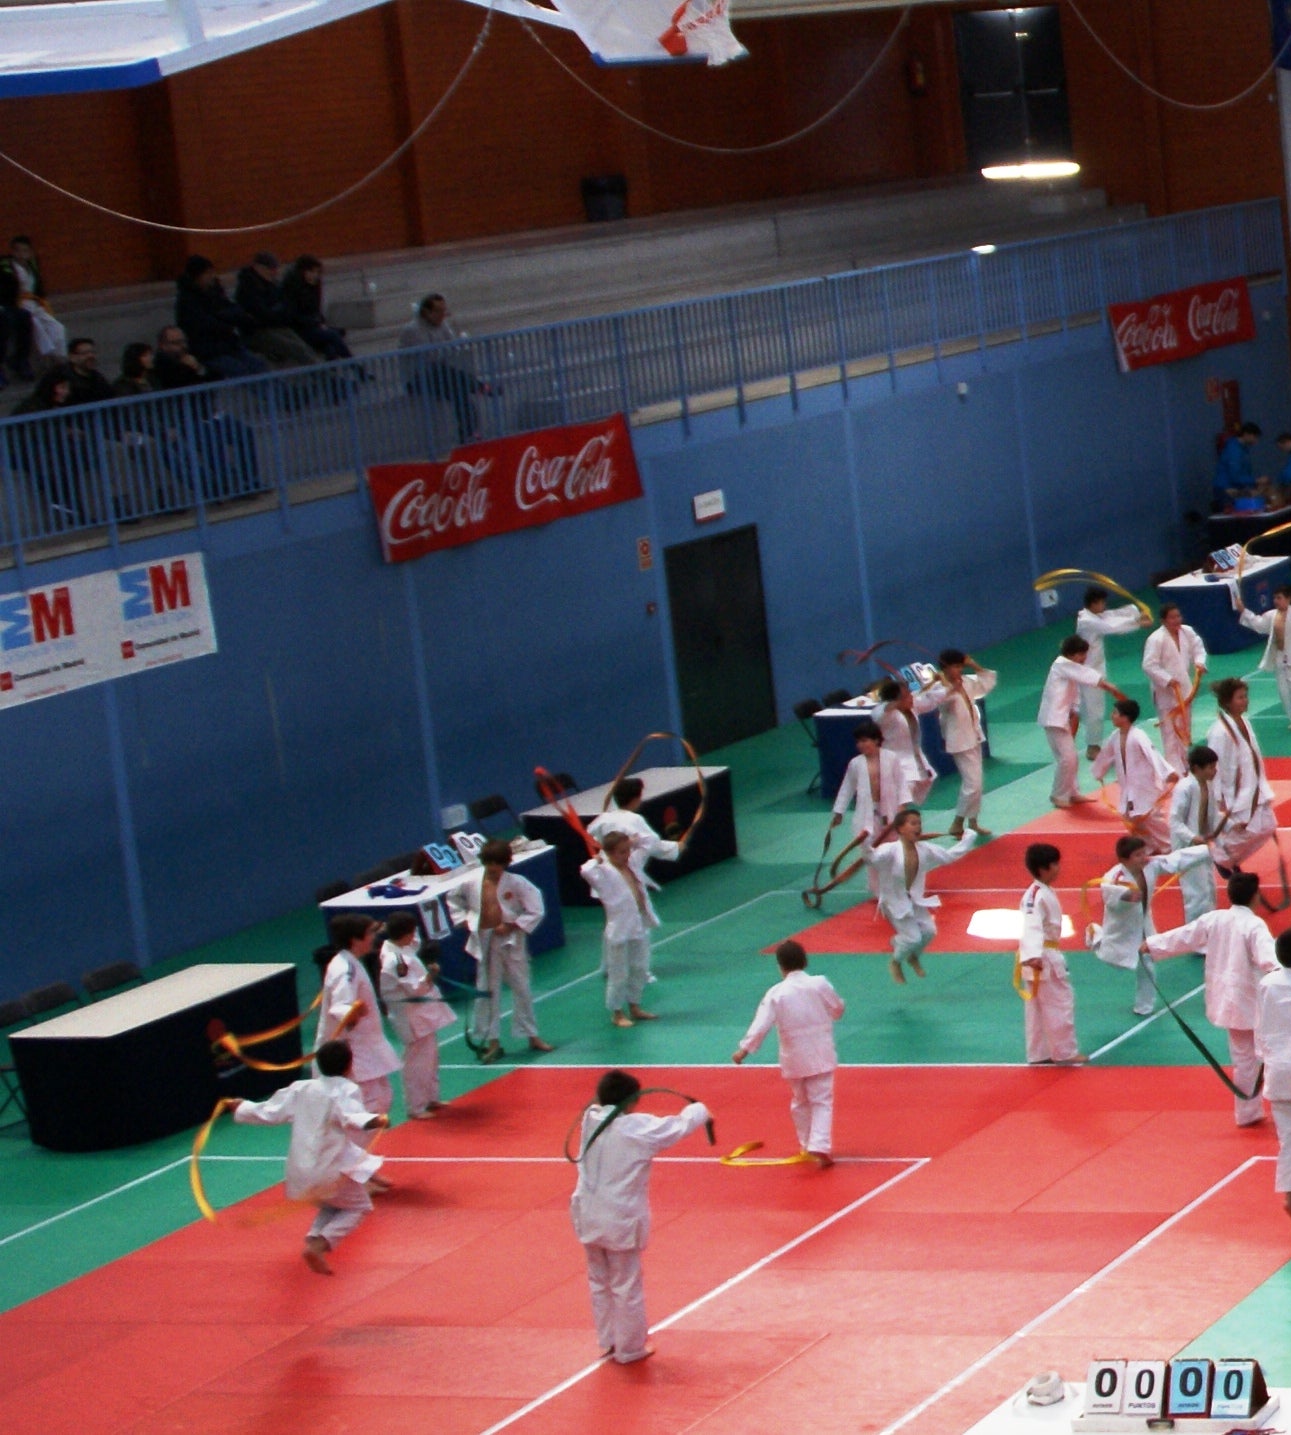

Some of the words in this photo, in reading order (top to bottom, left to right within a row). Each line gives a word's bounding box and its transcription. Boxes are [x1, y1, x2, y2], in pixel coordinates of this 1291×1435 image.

[515, 430, 617, 511] Coca-Cola
[423, 899, 442, 933] 7
[1094, 1367, 1118, 1398] 0
[1134, 1369, 1155, 1399] 0
[1178, 1366, 1203, 1398] 0
[1223, 1369, 1244, 1400] 0
